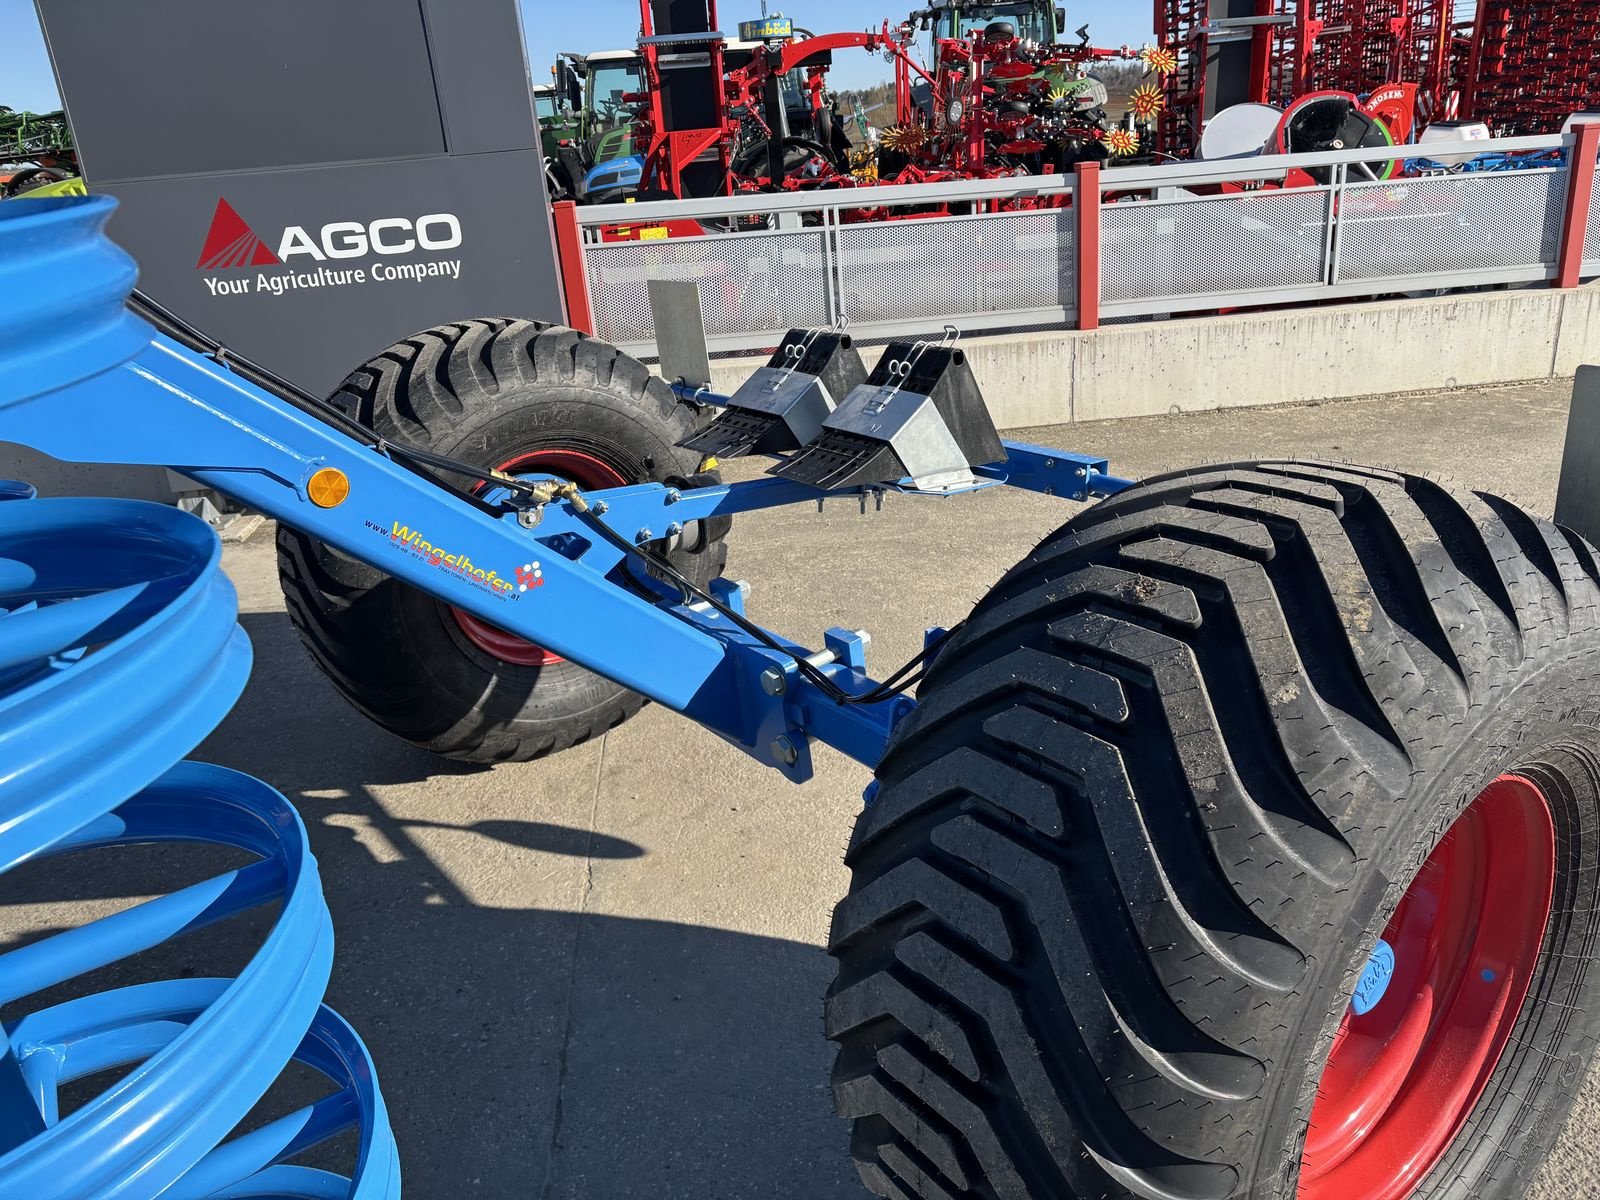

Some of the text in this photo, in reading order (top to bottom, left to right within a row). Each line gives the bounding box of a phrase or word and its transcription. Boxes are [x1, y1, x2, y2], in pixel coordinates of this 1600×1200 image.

[277, 213, 462, 263] AGCO
[203, 259, 461, 296] Your Agriculture Company
